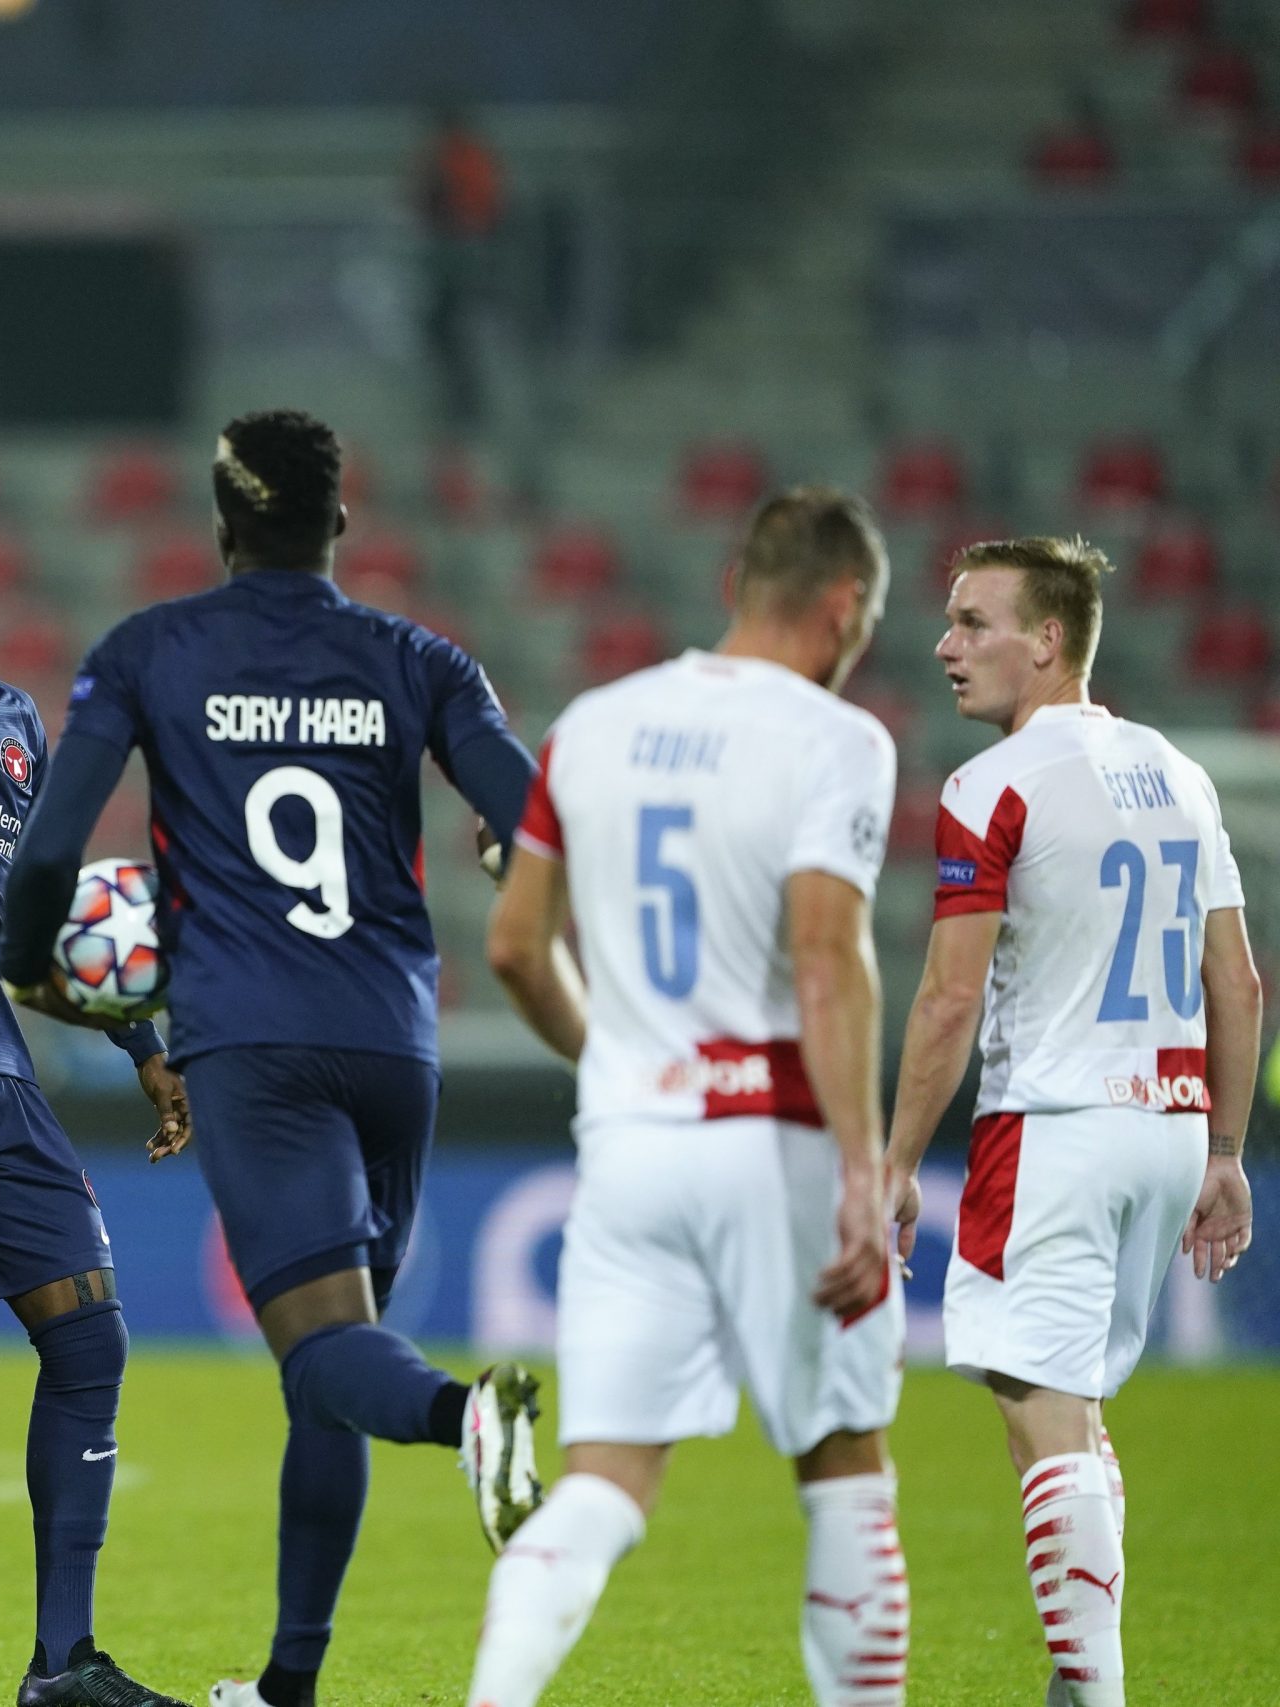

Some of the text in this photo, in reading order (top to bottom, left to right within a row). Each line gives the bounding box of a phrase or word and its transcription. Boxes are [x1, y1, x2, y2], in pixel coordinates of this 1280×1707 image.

[205, 694, 386, 747] SORY KABA
[1099, 761, 1177, 810] ŠEVČÍK
[244, 764, 355, 940] 9
[636, 803, 701, 1003] 5
[1096, 839, 1203, 1024] 23
